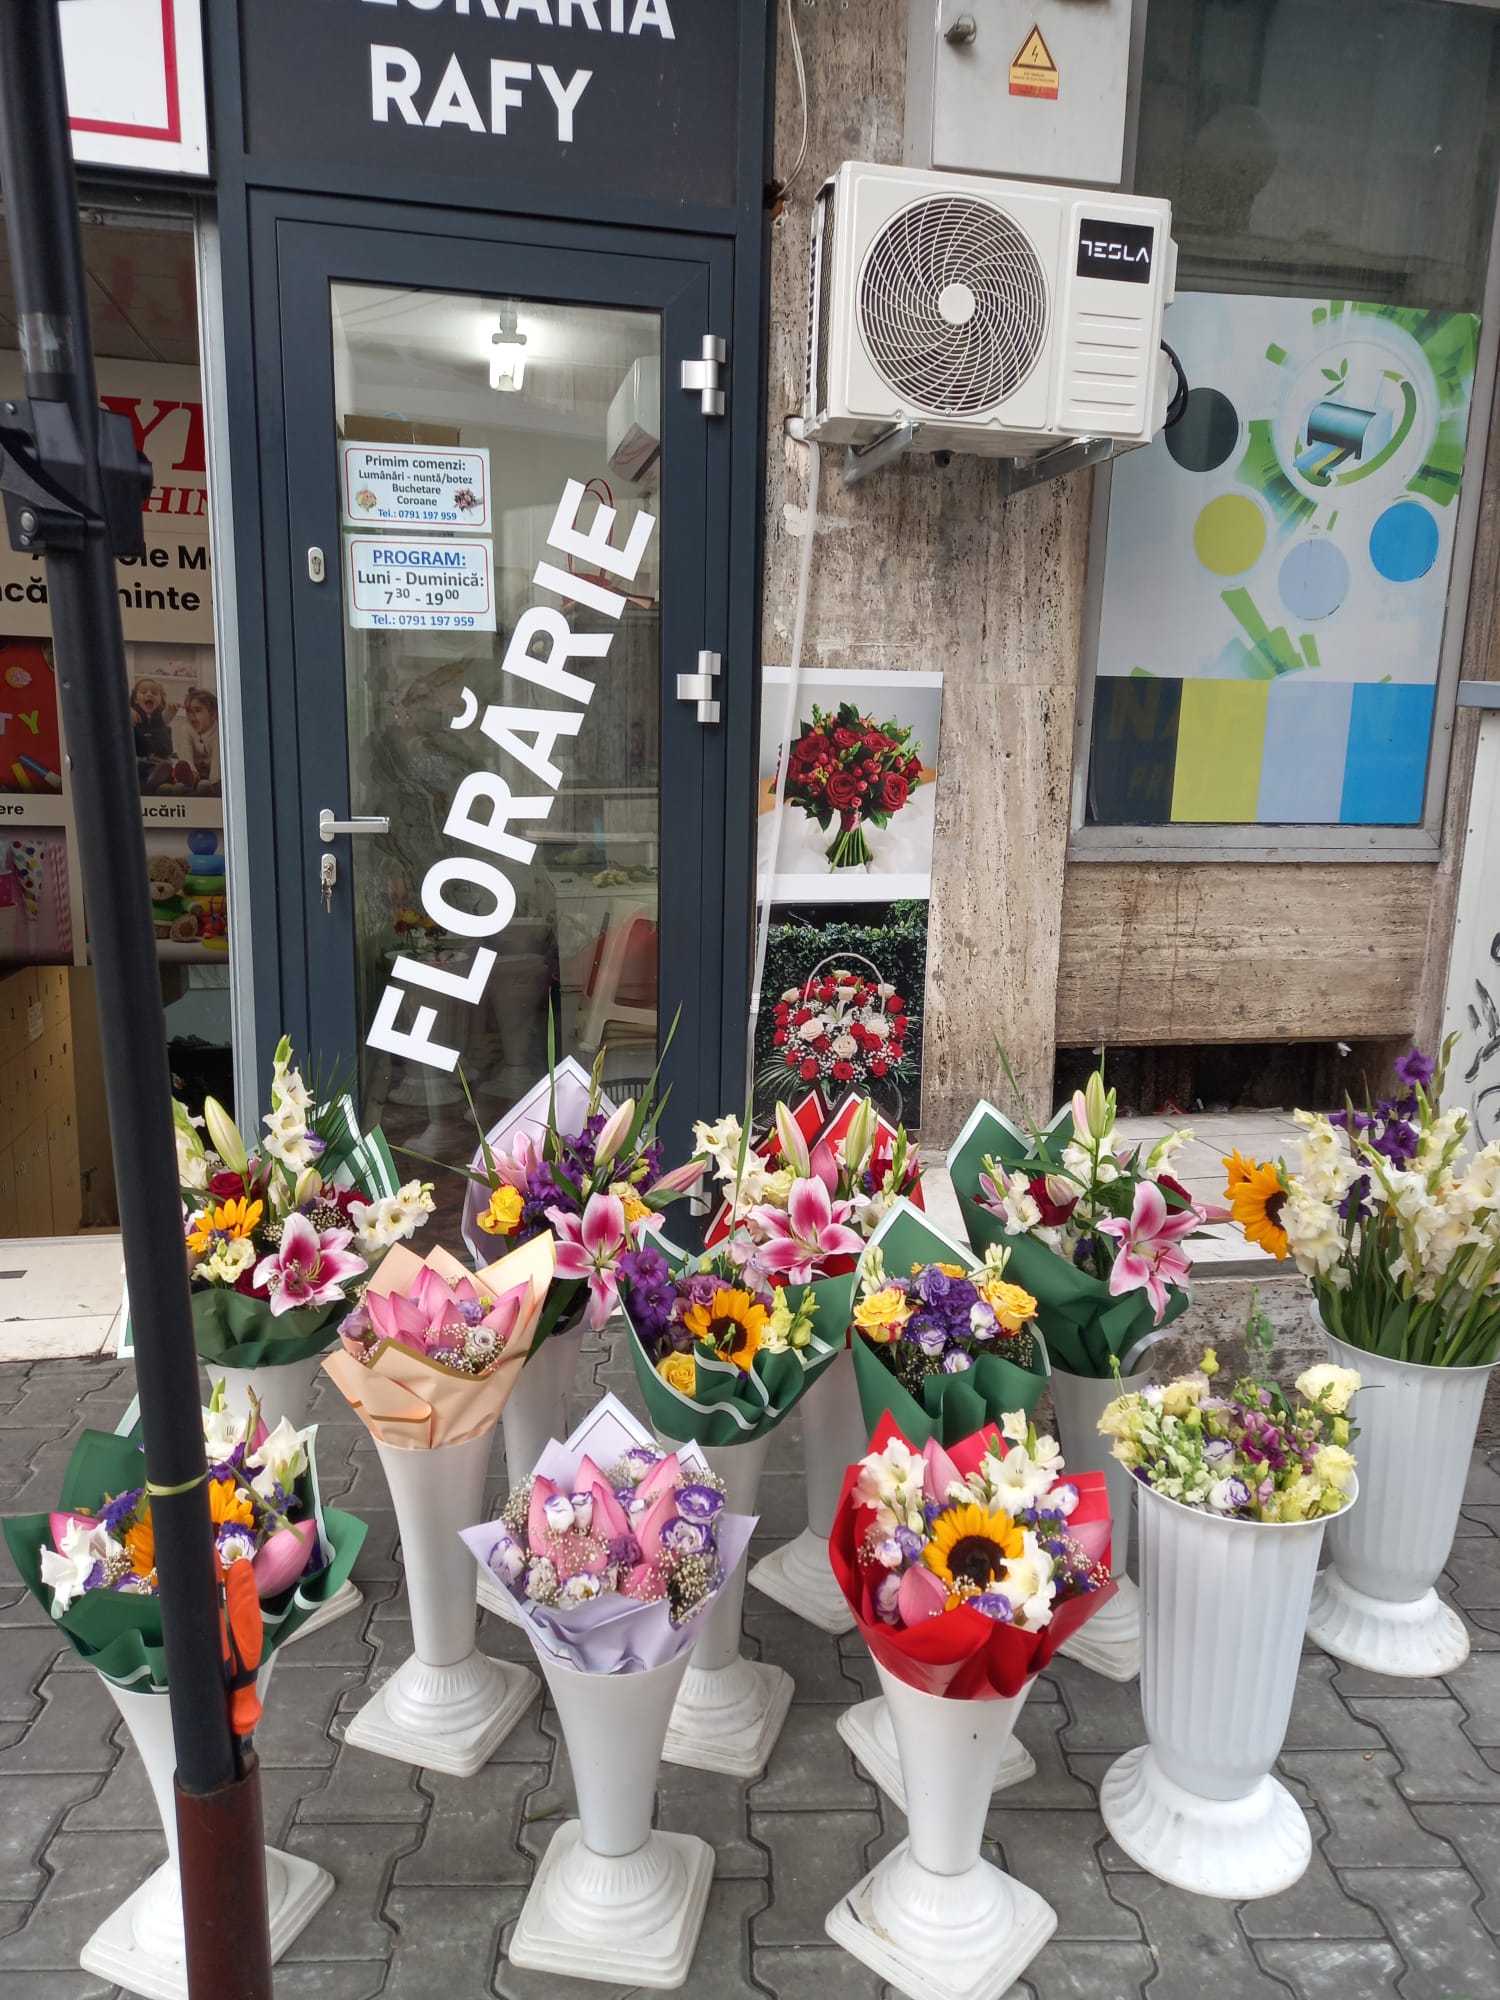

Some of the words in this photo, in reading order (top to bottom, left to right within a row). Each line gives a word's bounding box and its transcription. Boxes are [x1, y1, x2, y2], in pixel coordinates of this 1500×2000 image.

[370, 43, 593, 142] RAFY
[1080, 239, 1150, 263] TESLA
[365, 455, 409, 468] Primim
[412, 459, 466, 471] comenzi:
[358, 470, 405, 481] Lumânări
[413, 473, 473, 484] nuntă/botez
[392, 484, 441, 495] Buchetare
[397, 495, 437, 506] Coroane
[398, 510, 420, 519] 0791
[423, 511, 438, 520] 197
[441, 511, 457, 521] 959
[373, 550, 467, 567] PROGRAM:
[358, 570, 391, 585] Luni
[406, 572, 484, 587] Duminică:
[372, 614, 396, 625] Tel.:
[398, 615, 426, 626] 0791
[431, 616, 450, 626] 197
[454, 616, 475, 627] 959
[366, 478, 656, 1072] FLORĂRIE
